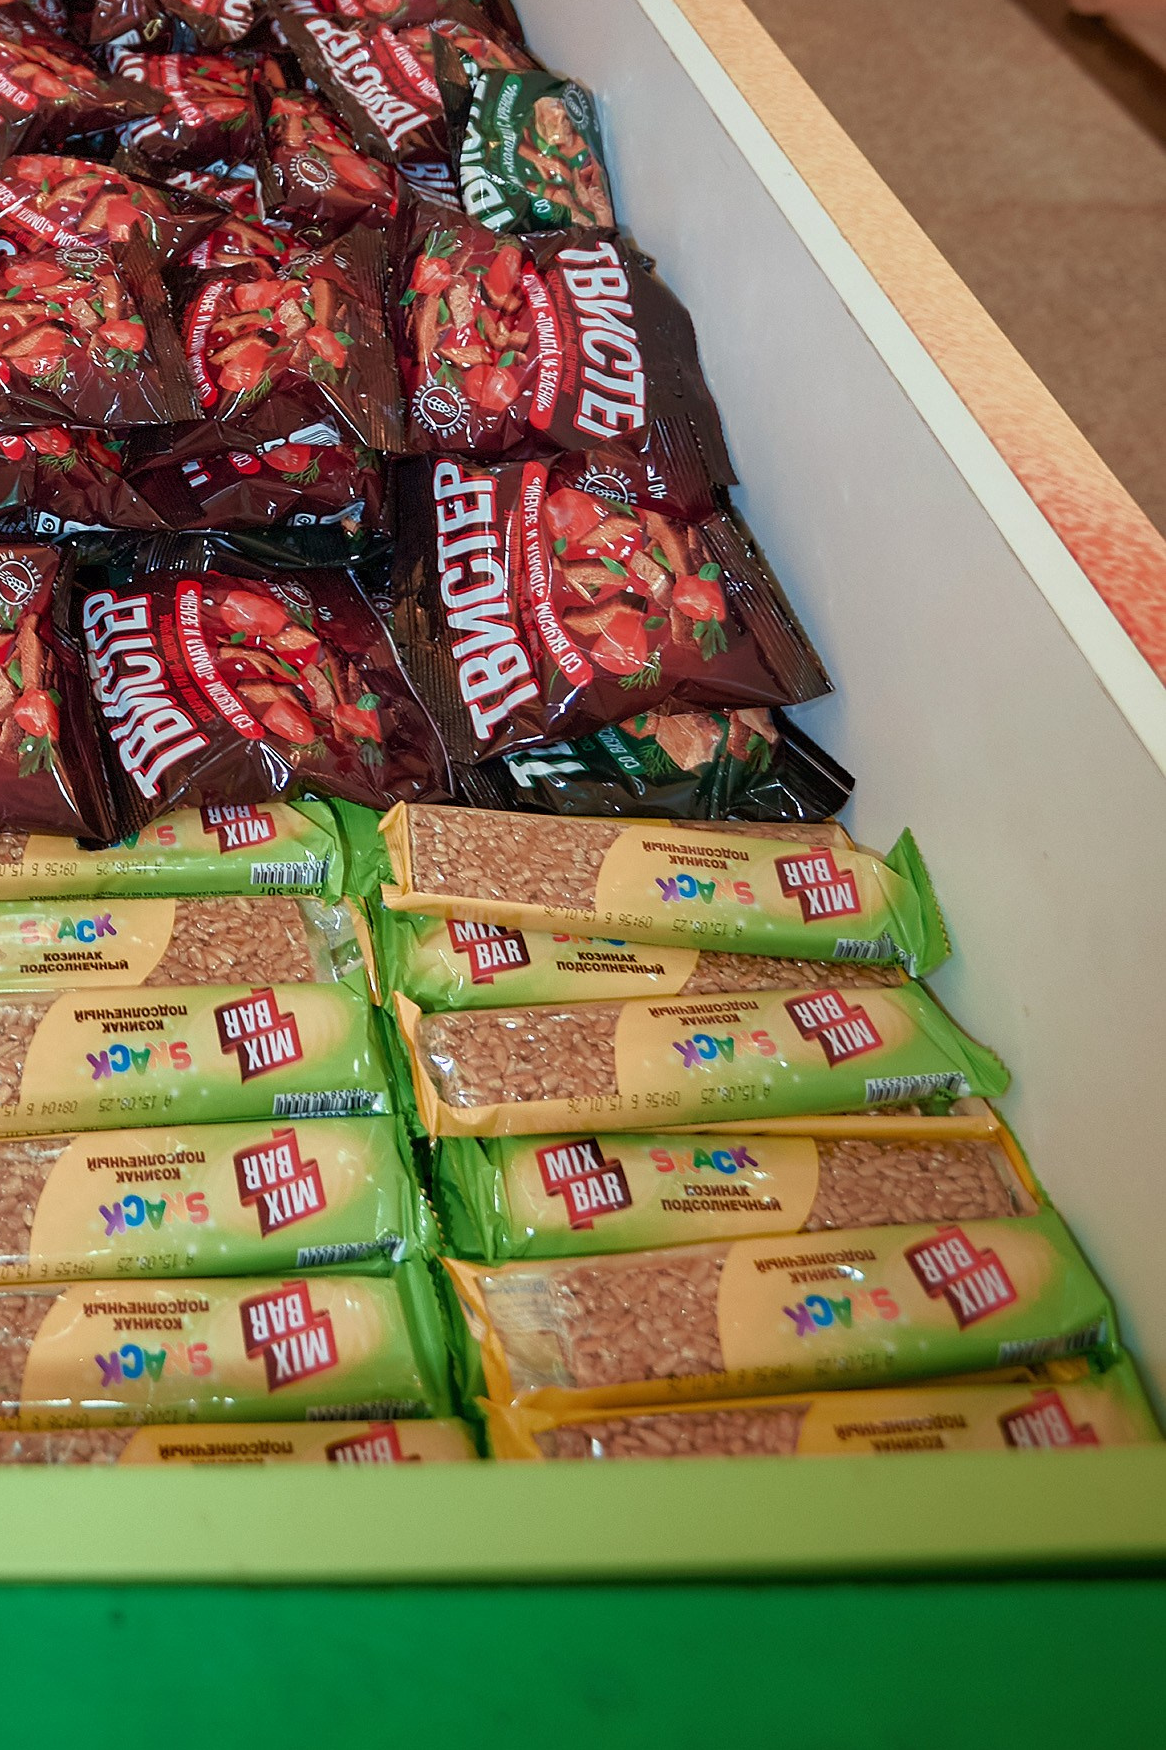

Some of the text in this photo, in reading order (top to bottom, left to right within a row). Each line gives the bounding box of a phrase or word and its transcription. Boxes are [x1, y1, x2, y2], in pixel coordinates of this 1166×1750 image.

[12, 91, 29, 105] СО
[305, 18, 432, 151] ТВИСТЕР
[533, 198, 552, 216] СО
[535, 312, 561, 412] «ТОМАТА ЗЕЛЕНИ»
[523, 476, 583, 674] СО ВКУСОМ «ТОМАТА И ЗЕЛЕНИ»
[183, 588, 200, 629] ЗЕЛЕНИ»
[434, 459, 539, 741] ТВИСТЕР
[192, 640, 216, 684] «ТОМАТА
[83, 590, 210, 799] ТВИСТЕР
[211, 682, 244, 716] ВКУСОМ
[234, 713, 253, 730] СО
[227, 820, 269, 847] MIX
[642, 840, 749, 860] ПОДСОЛНЕЧНЫЙ
[670, 854, 727, 868] КОЗИНАК
[780, 859, 831, 884] BAR
[656, 874, 754, 905] SNACK
[806, 882, 855, 914] MIX
[20, 914, 116, 944] SNACK
[20, 959, 128, 973] ПОДСОЛНЕЧНЫЙ
[43, 951, 102, 962] КОЗИНАК
[477, 940, 524, 969] BAR
[556, 959, 665, 976] ПОДСОЛНЕЧНЫЙ
[578, 951, 636, 963] КОЗИНАК
[74, 1004, 187, 1021] ПОДСОЛНЕЧНЫЙ
[224, 1000, 272, 1038] BAR
[648, 1001, 759, 1018] ПОДСОЛНЕЧНЫЙ
[680, 1011, 740, 1026] КОЗИНАК
[793, 996, 844, 1027] BAR
[103, 1021, 164, 1033] КОЗИНАК
[827, 1017, 874, 1054] MIX
[86, 1042, 191, 1079] SNACK
[247, 1027, 294, 1069] MIX
[673, 1030, 776, 1068] SNACK
[87, 1150, 206, 1170] ПОДСОЛНЕЧНЫЙ
[117, 1167, 182, 1183] КОЗИНАК
[243, 1143, 296, 1190] BAR
[545, 1146, 597, 1180] MIX
[650, 1147, 759, 1173] SNACK
[264, 1174, 318, 1226] MIX
[570, 1175, 623, 1210] BAR
[662, 1197, 781, 1211] ПОДСОЛНЕЧНЫЙ
[98, 1191, 208, 1237] SNACK
[753, 1250, 876, 1273] ПОДСОЛНЕЧНЫЙ
[913, 1233, 969, 1280] BAR
[954, 1266, 1006, 1312] MIX
[83, 1300, 209, 1317] ПОДСОЛНЕЧНЫЙ
[114, 1314, 182, 1330] КОЗИНАК
[251, 1294, 307, 1342] BAR
[784, 1288, 899, 1336] SNACK
[94, 1343, 212, 1386] SNACK
[272, 1328, 330, 1379] MIX
